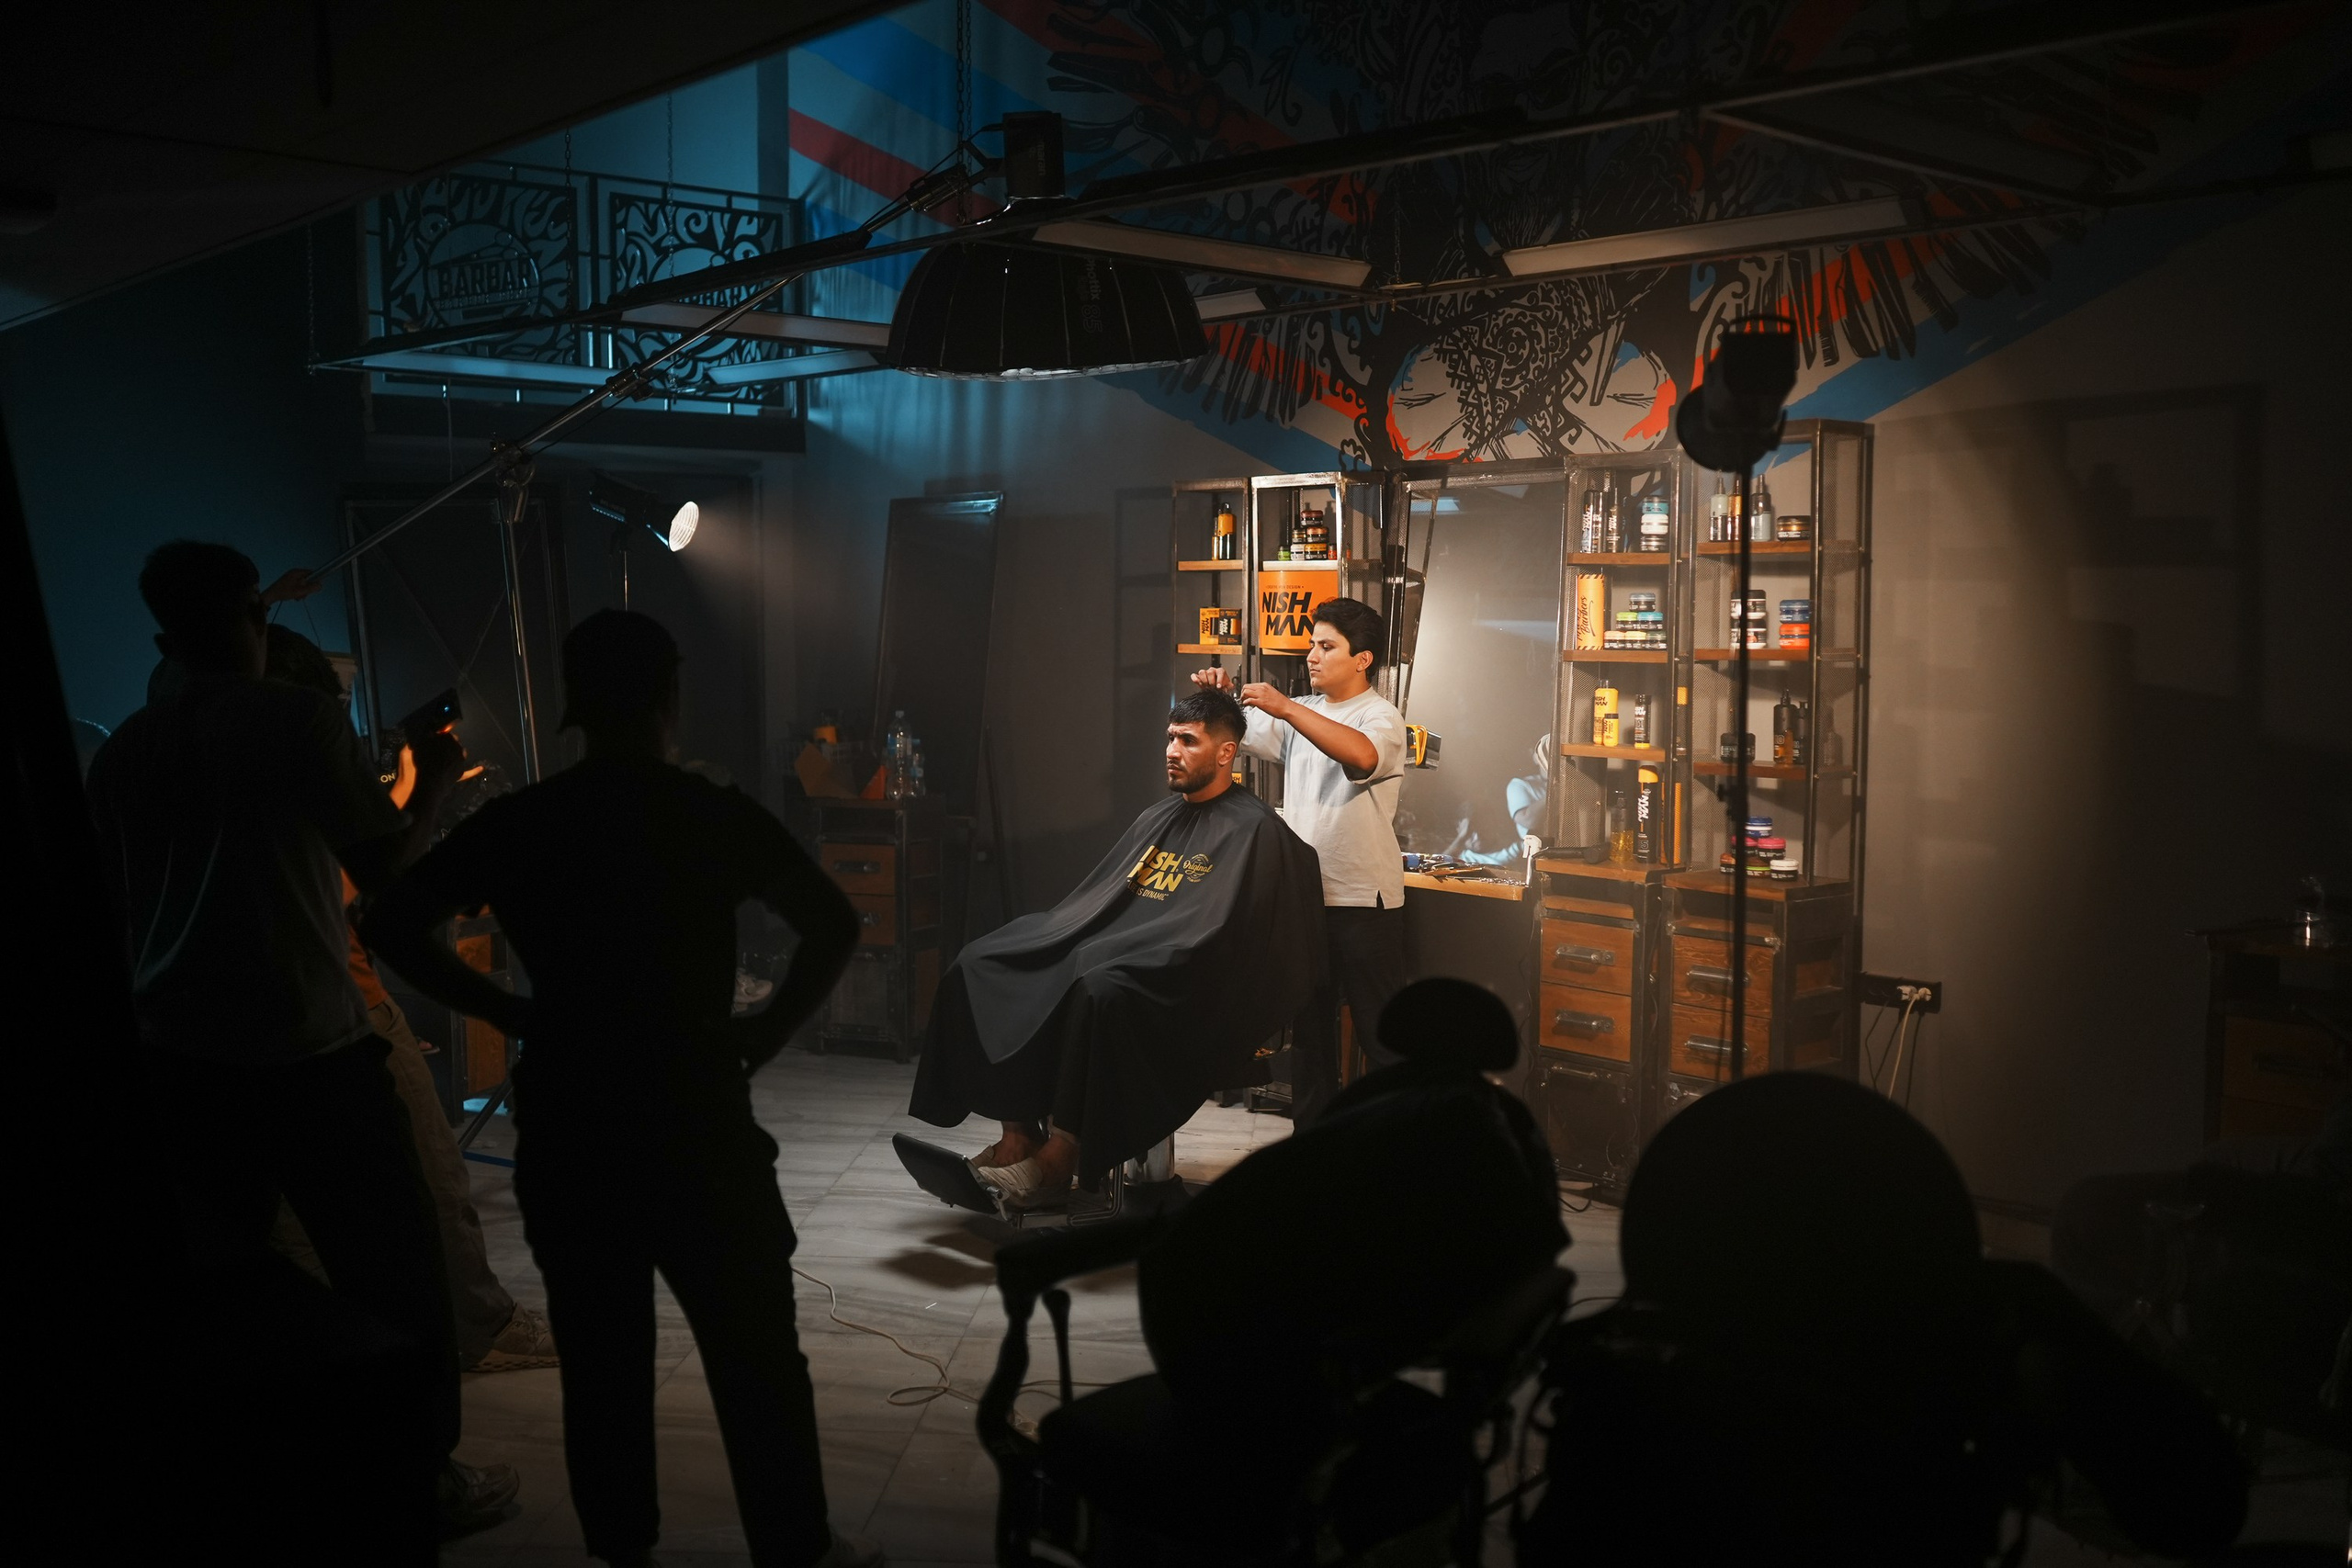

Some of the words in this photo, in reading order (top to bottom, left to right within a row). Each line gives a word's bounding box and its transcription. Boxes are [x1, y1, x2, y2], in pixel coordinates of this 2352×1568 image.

[438, 259, 529, 299] BARBAR
[1081, 304, 1103, 333] 85
[1262, 592, 1312, 614] NISH
[1579, 595, 1590, 635] Barbers
[1266, 615, 1314, 636] MAN
[1126, 862, 1185, 892] MAN
[1183, 860, 1214, 875] Original
